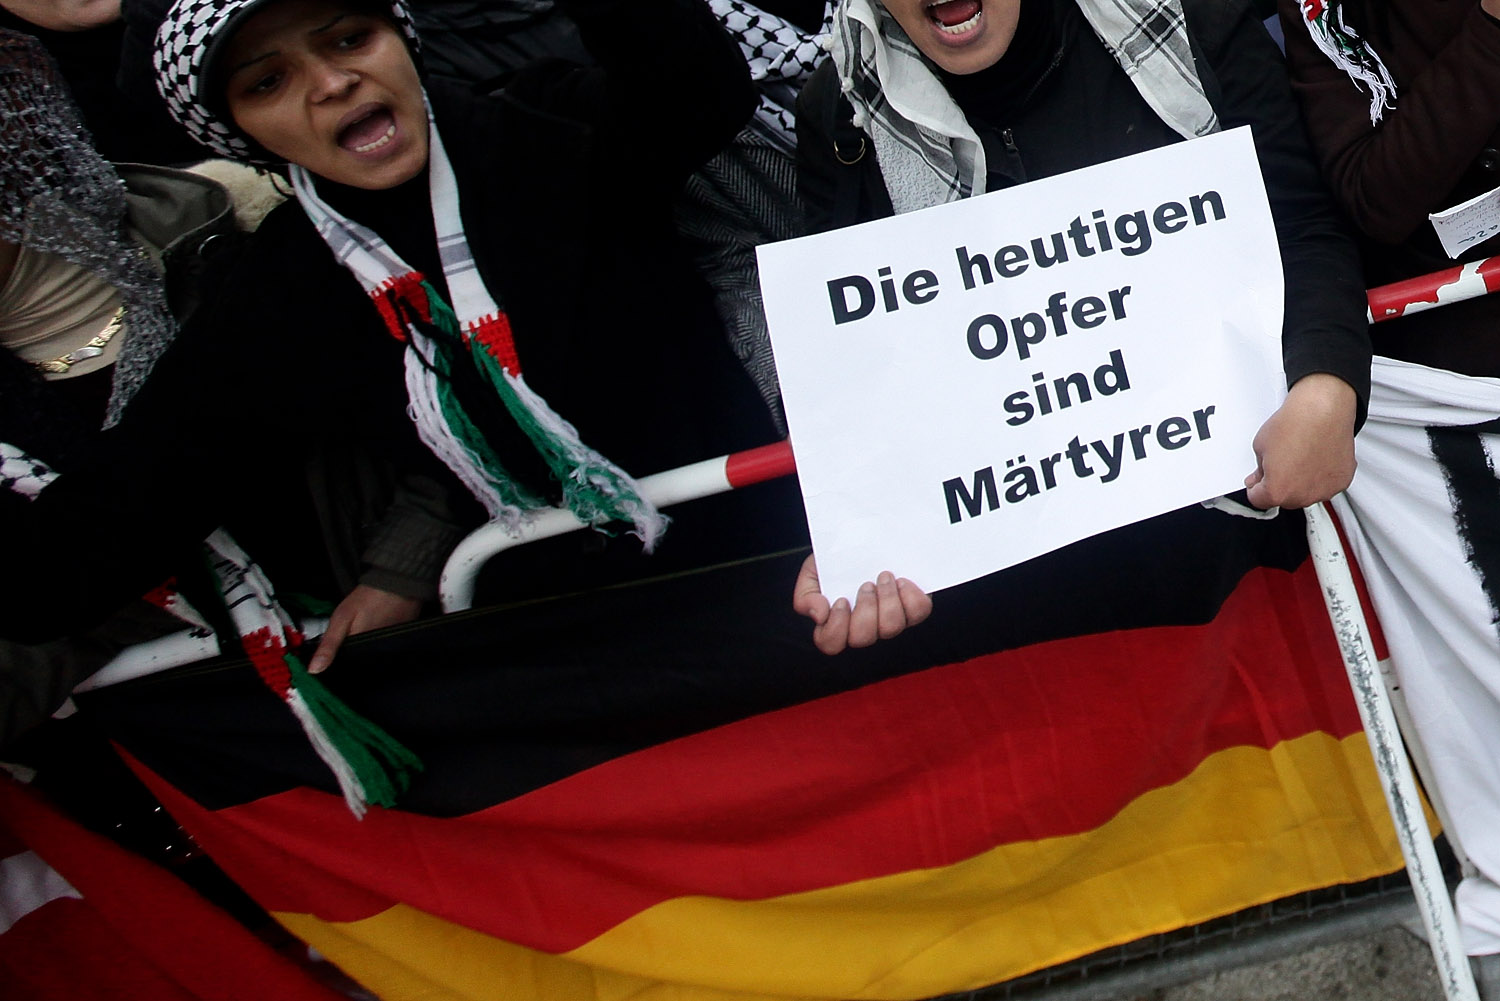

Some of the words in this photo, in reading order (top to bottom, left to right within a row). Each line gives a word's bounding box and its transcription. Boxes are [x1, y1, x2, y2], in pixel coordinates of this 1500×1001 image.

[826, 266, 940, 325] Die
[955, 190, 1227, 291] heutigen
[966, 285, 1132, 361] Opfer
[1002, 349, 1131, 427] sind
[942, 405, 1217, 525] Märtyrer
